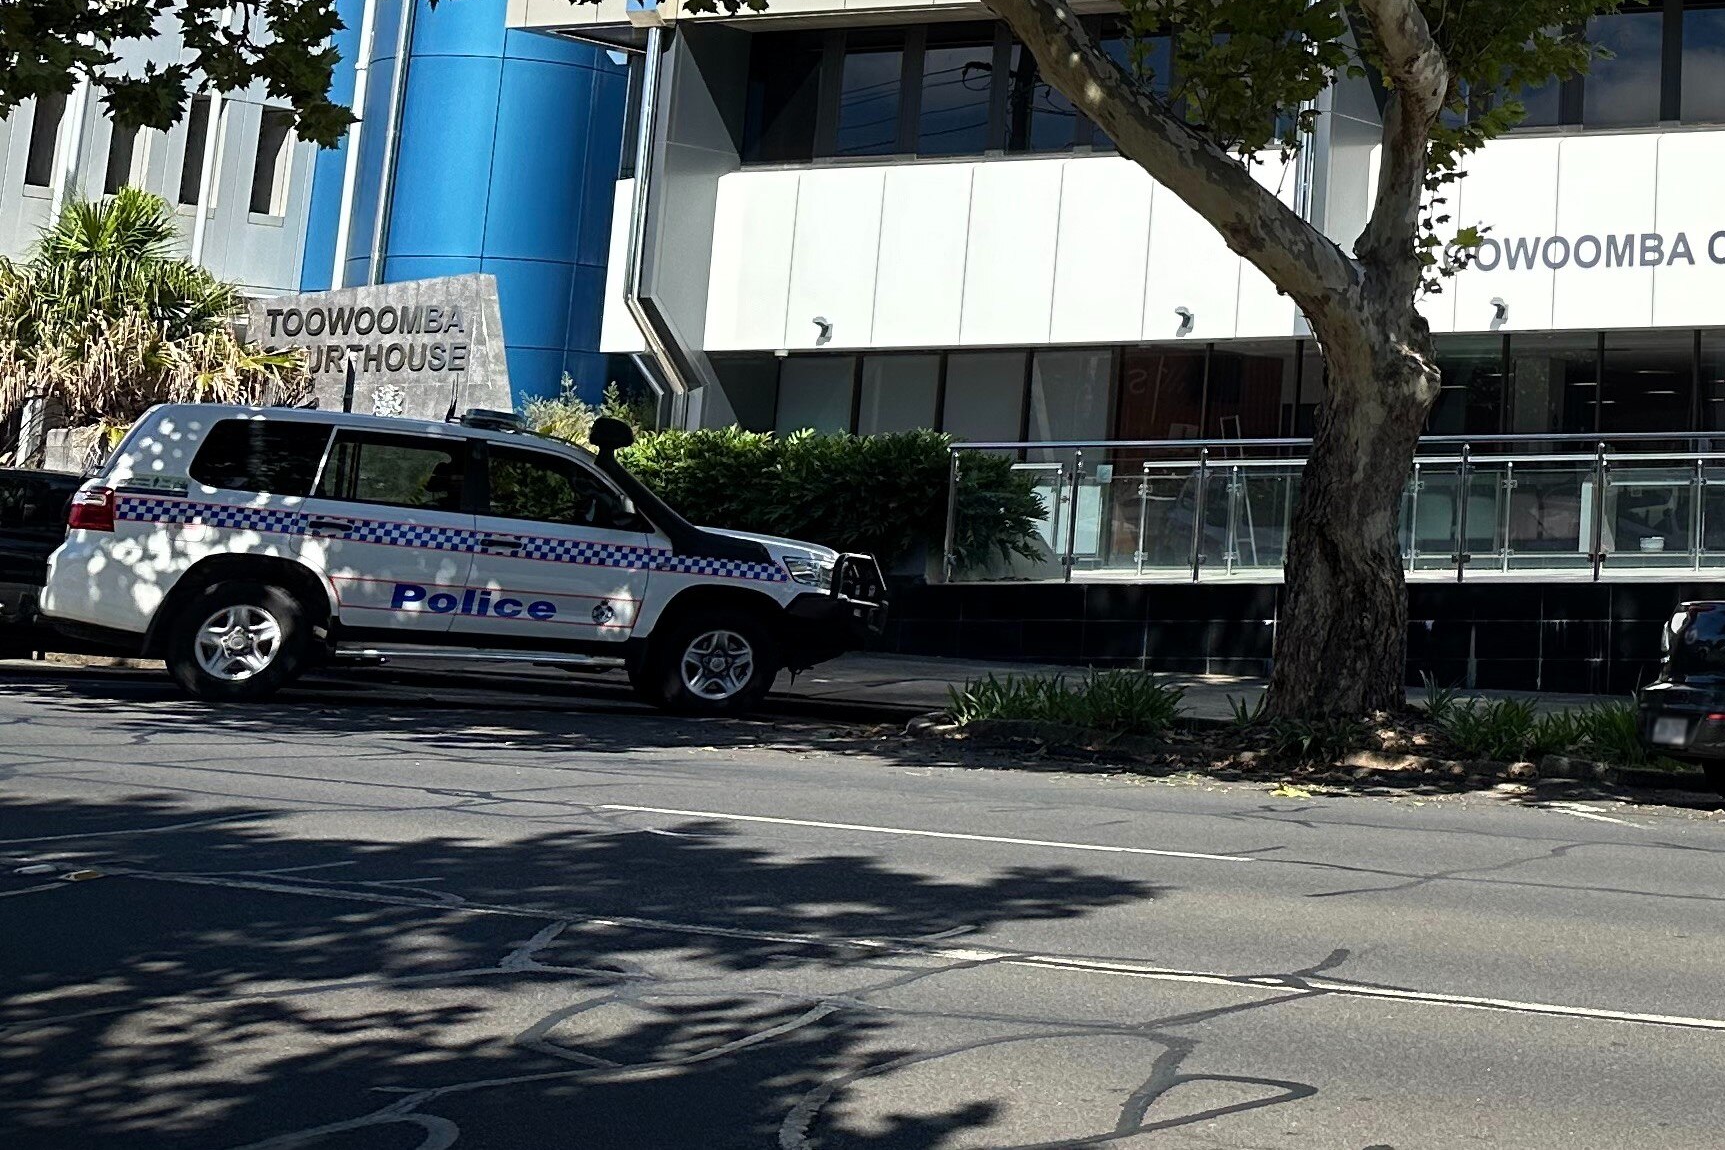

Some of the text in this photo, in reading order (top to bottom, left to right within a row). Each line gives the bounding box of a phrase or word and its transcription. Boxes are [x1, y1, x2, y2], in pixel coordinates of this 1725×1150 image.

[1421, 232, 1696, 273] OOWOOMBA
[266, 304, 465, 338] TOOWOOMBA
[264, 342, 471, 374] URTHOUSE
[390, 583, 557, 621] Police
